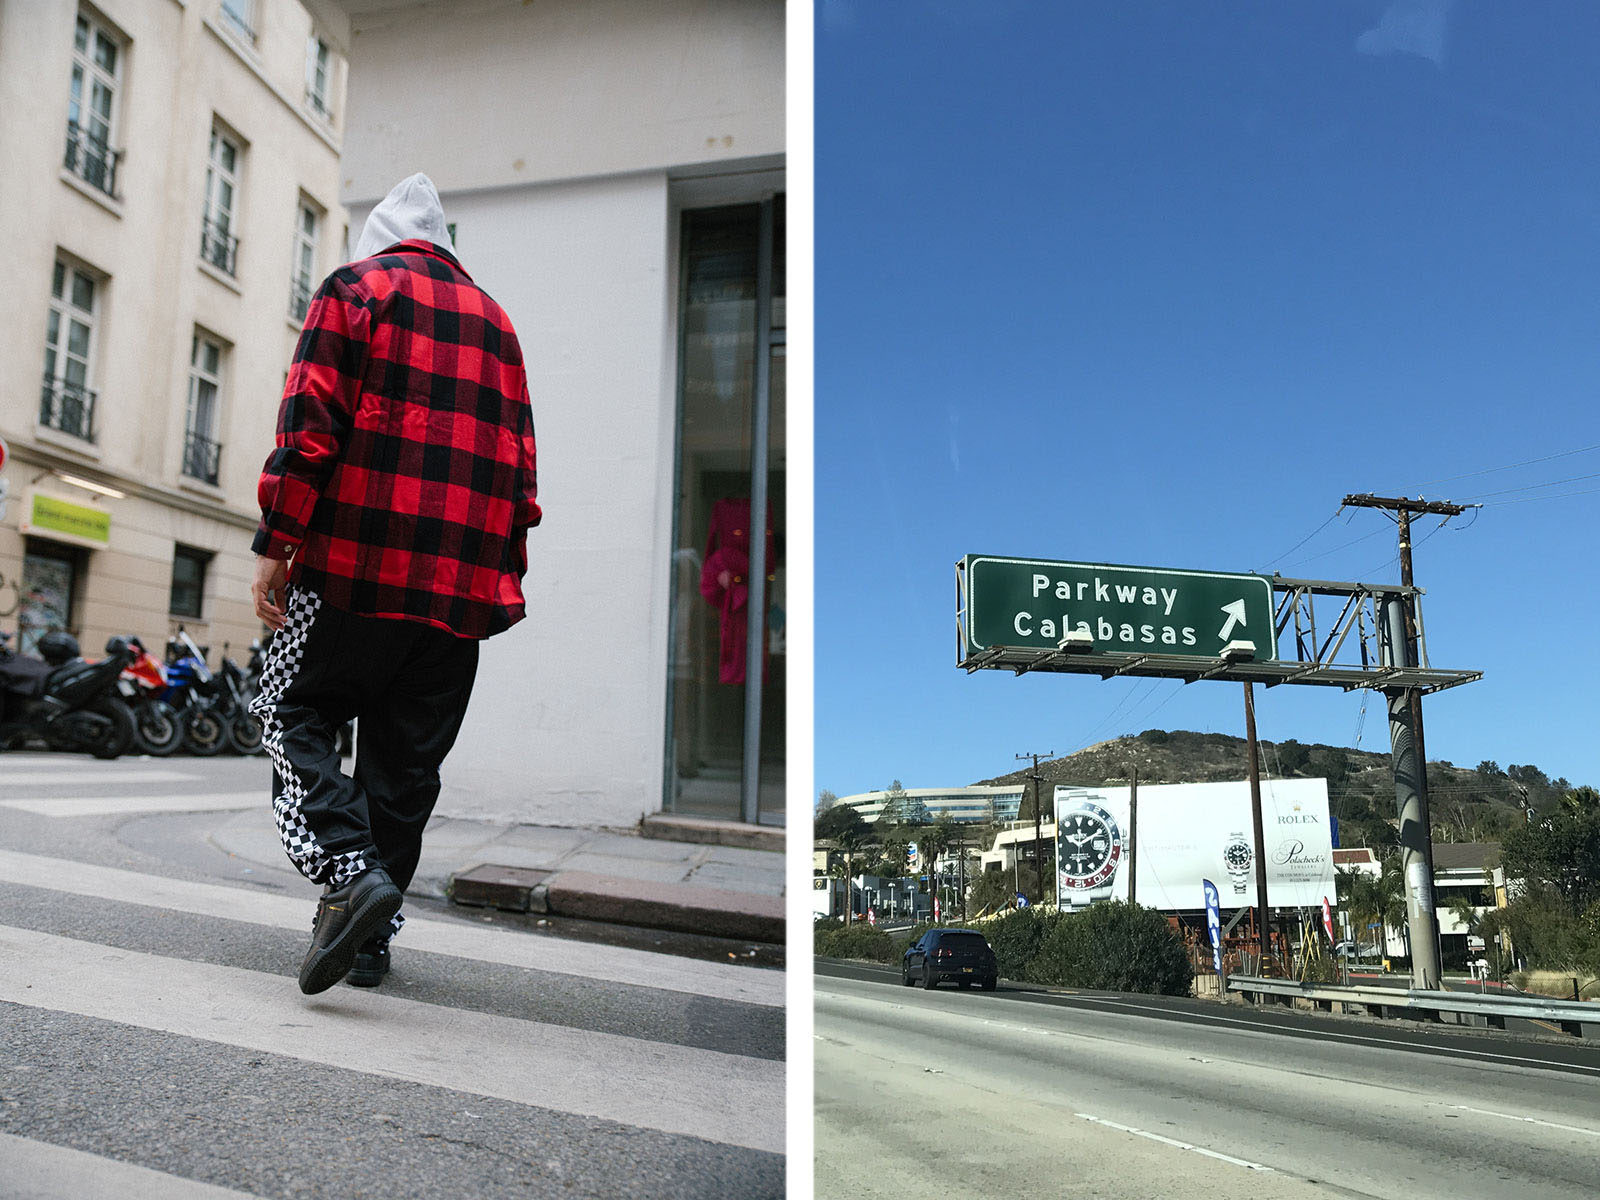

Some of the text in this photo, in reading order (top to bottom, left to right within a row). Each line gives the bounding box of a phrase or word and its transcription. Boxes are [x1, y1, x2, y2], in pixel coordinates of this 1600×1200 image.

[1032, 574, 1178, 616] Parkway
[1013, 611, 1197, 646] Calabasas
[1278, 814, 1319, 825] ROLEX
[1074, 879, 1087, 888] 12
